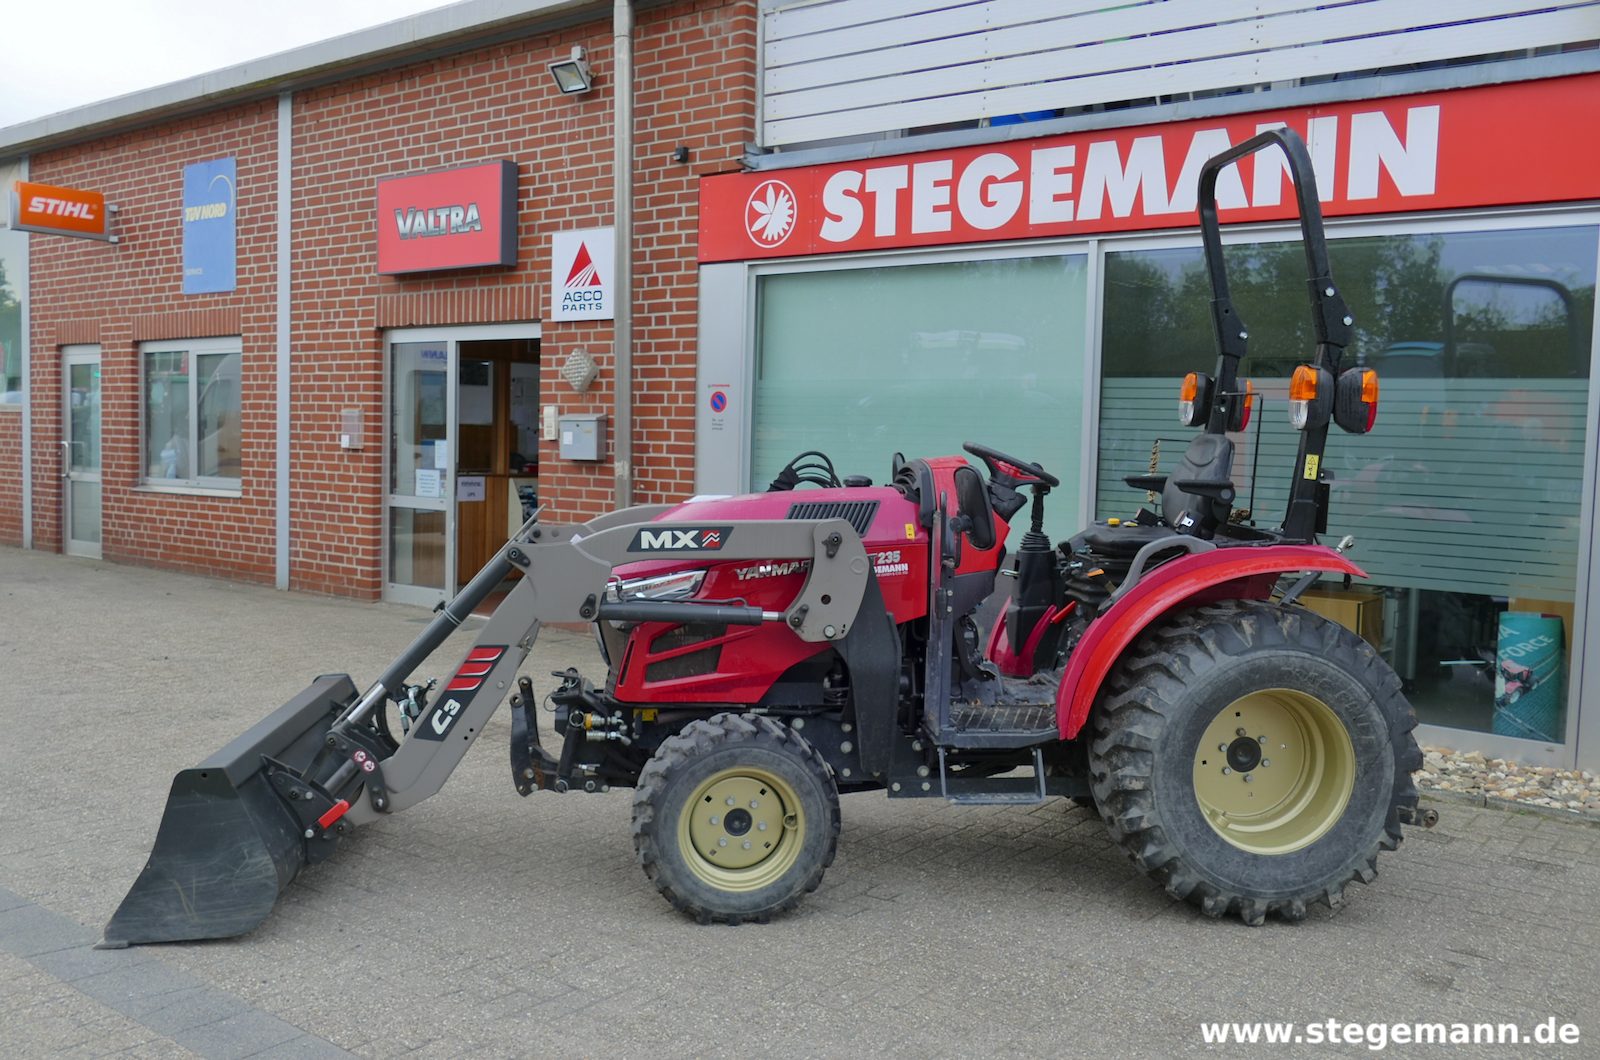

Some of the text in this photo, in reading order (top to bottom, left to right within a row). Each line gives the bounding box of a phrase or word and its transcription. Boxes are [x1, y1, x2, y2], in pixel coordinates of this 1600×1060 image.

[819, 104, 1441, 243] STEGEMANN
[28, 196, 95, 220] STIHL
[200, 202, 227, 219] NORD
[393, 202, 483, 240] VALTRA
[562, 290, 603, 303] AGCO
[562, 302, 603, 311] PARTS
[640, 530, 699, 549] MX
[1498, 634, 1555, 661] FORCE
[431, 698, 461, 735] C3
